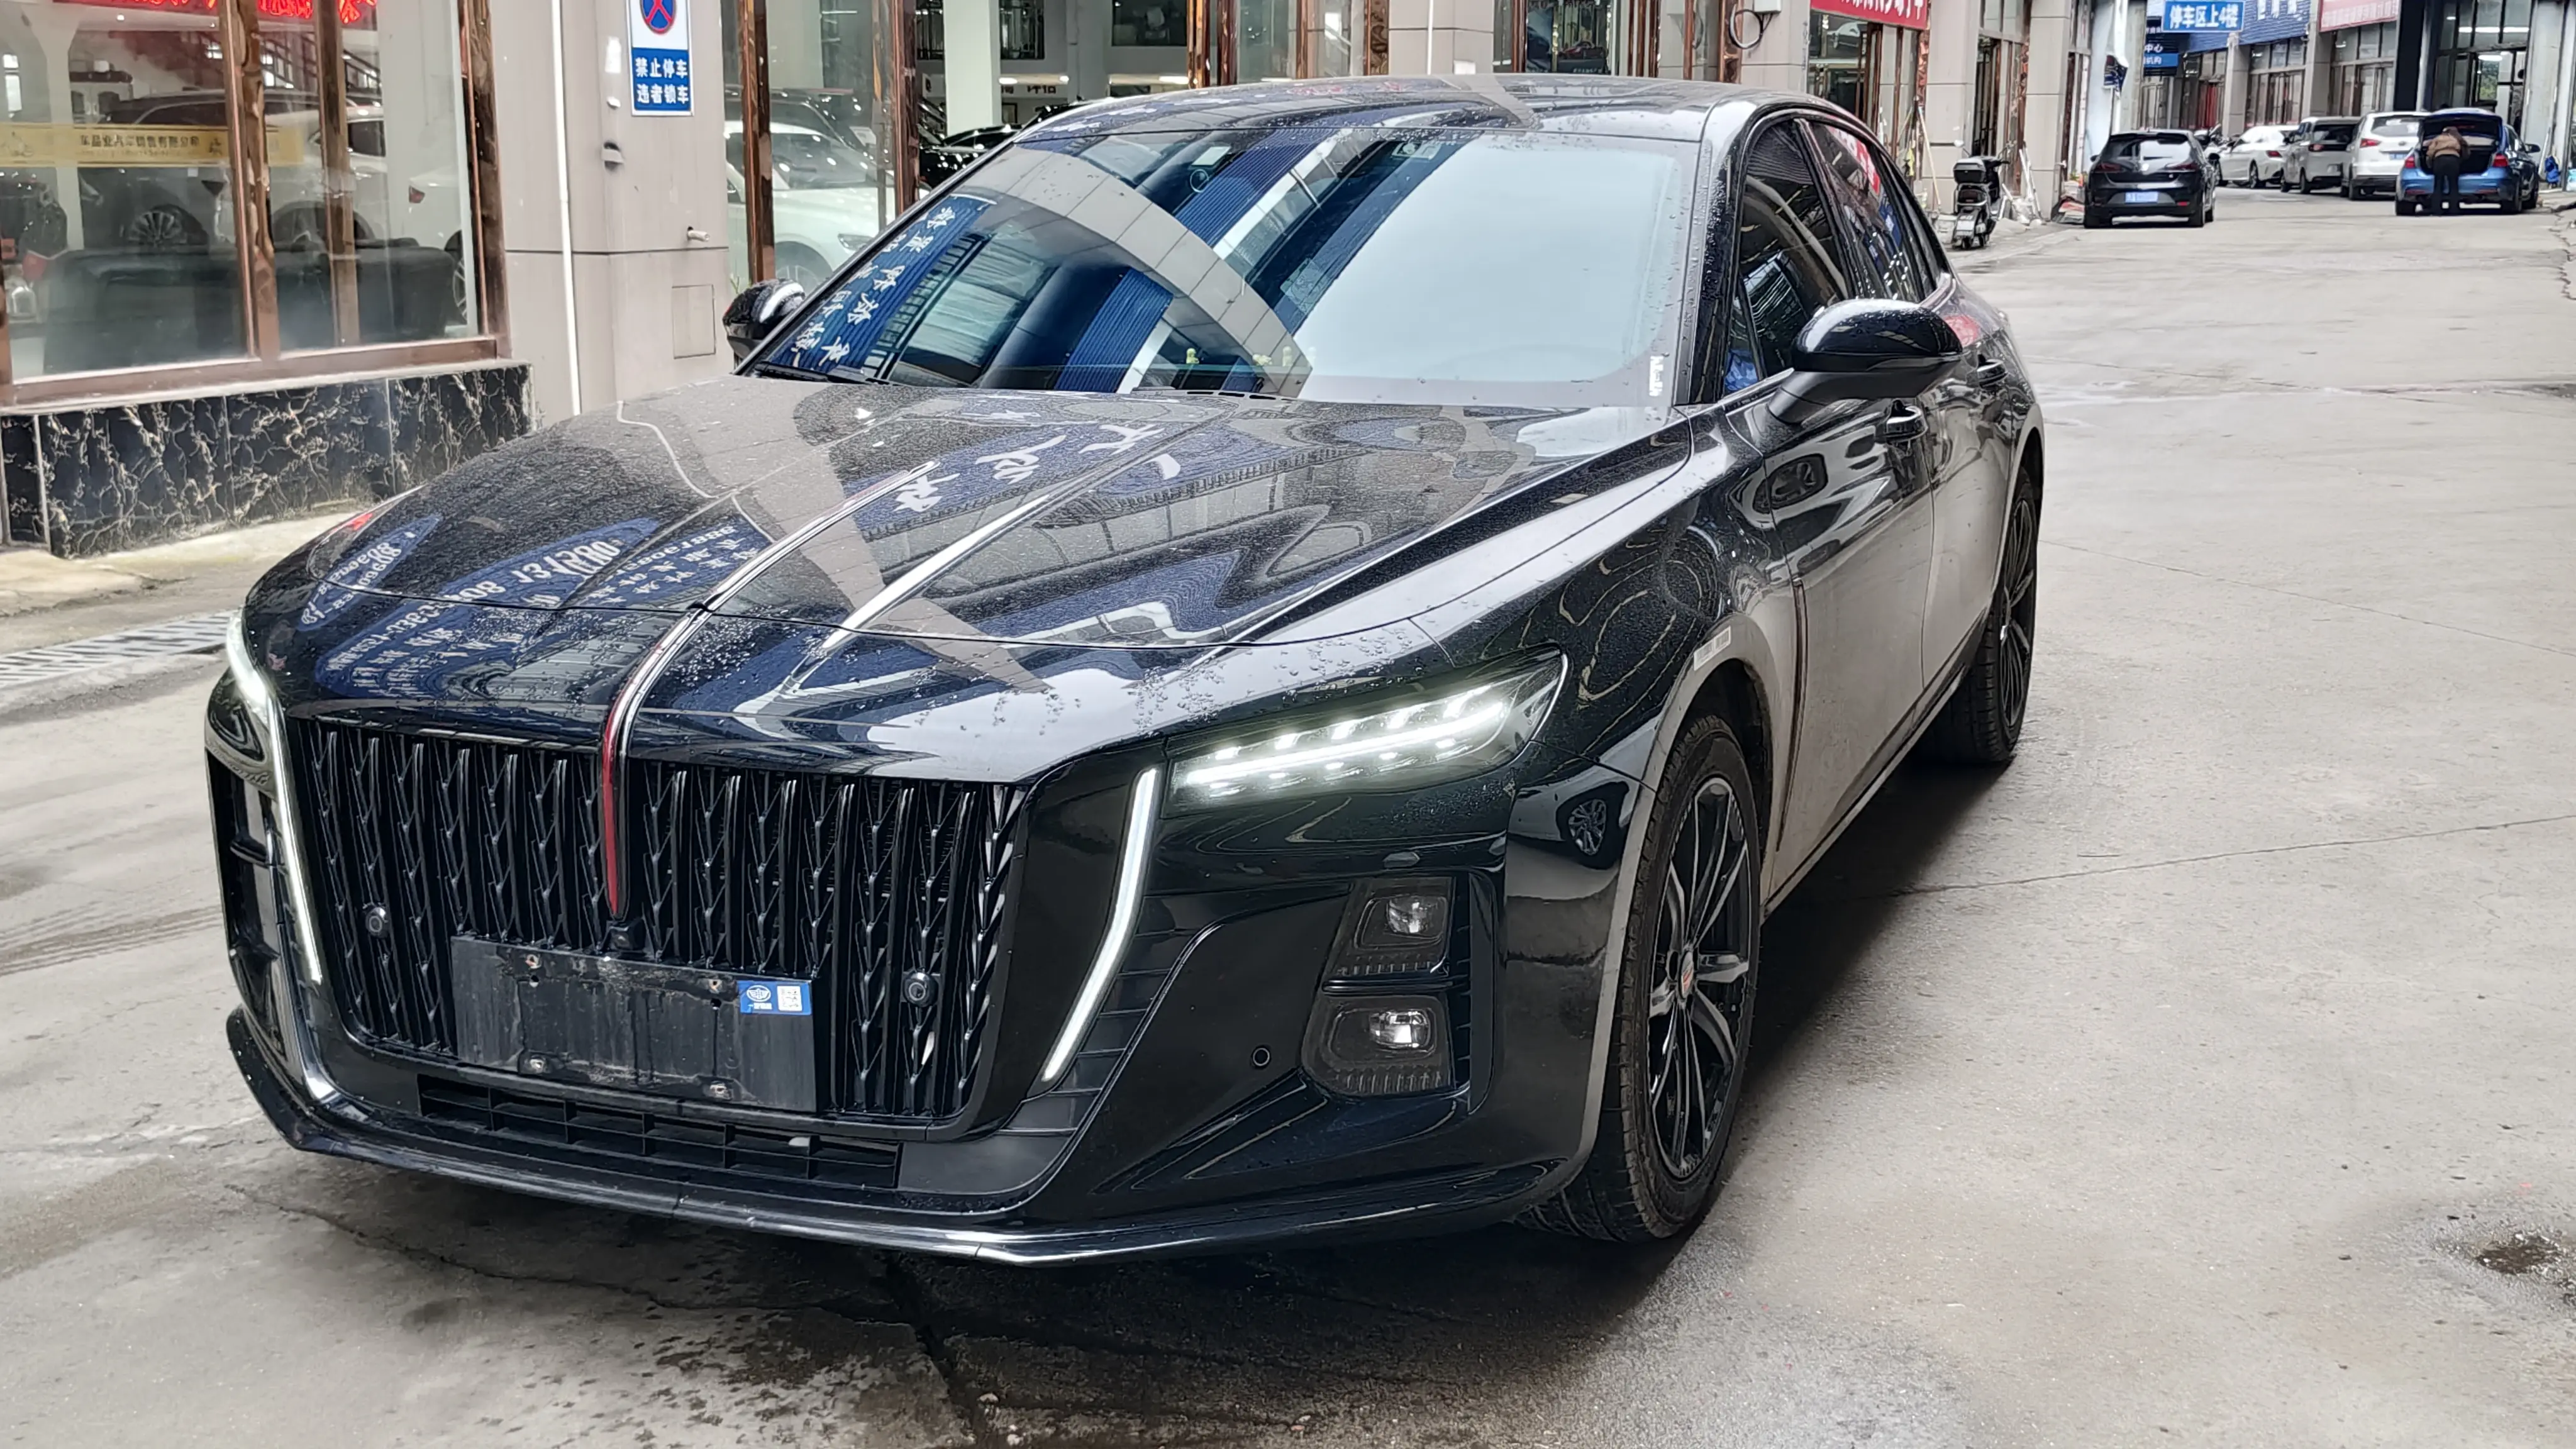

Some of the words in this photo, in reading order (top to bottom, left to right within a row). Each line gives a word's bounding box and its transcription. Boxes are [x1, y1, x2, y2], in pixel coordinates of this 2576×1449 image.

[2170, 4, 2238, 29] 停车区上4楼
[635, 57, 688, 79] 禁止停车
[636, 82, 689, 104] 违者锁车
